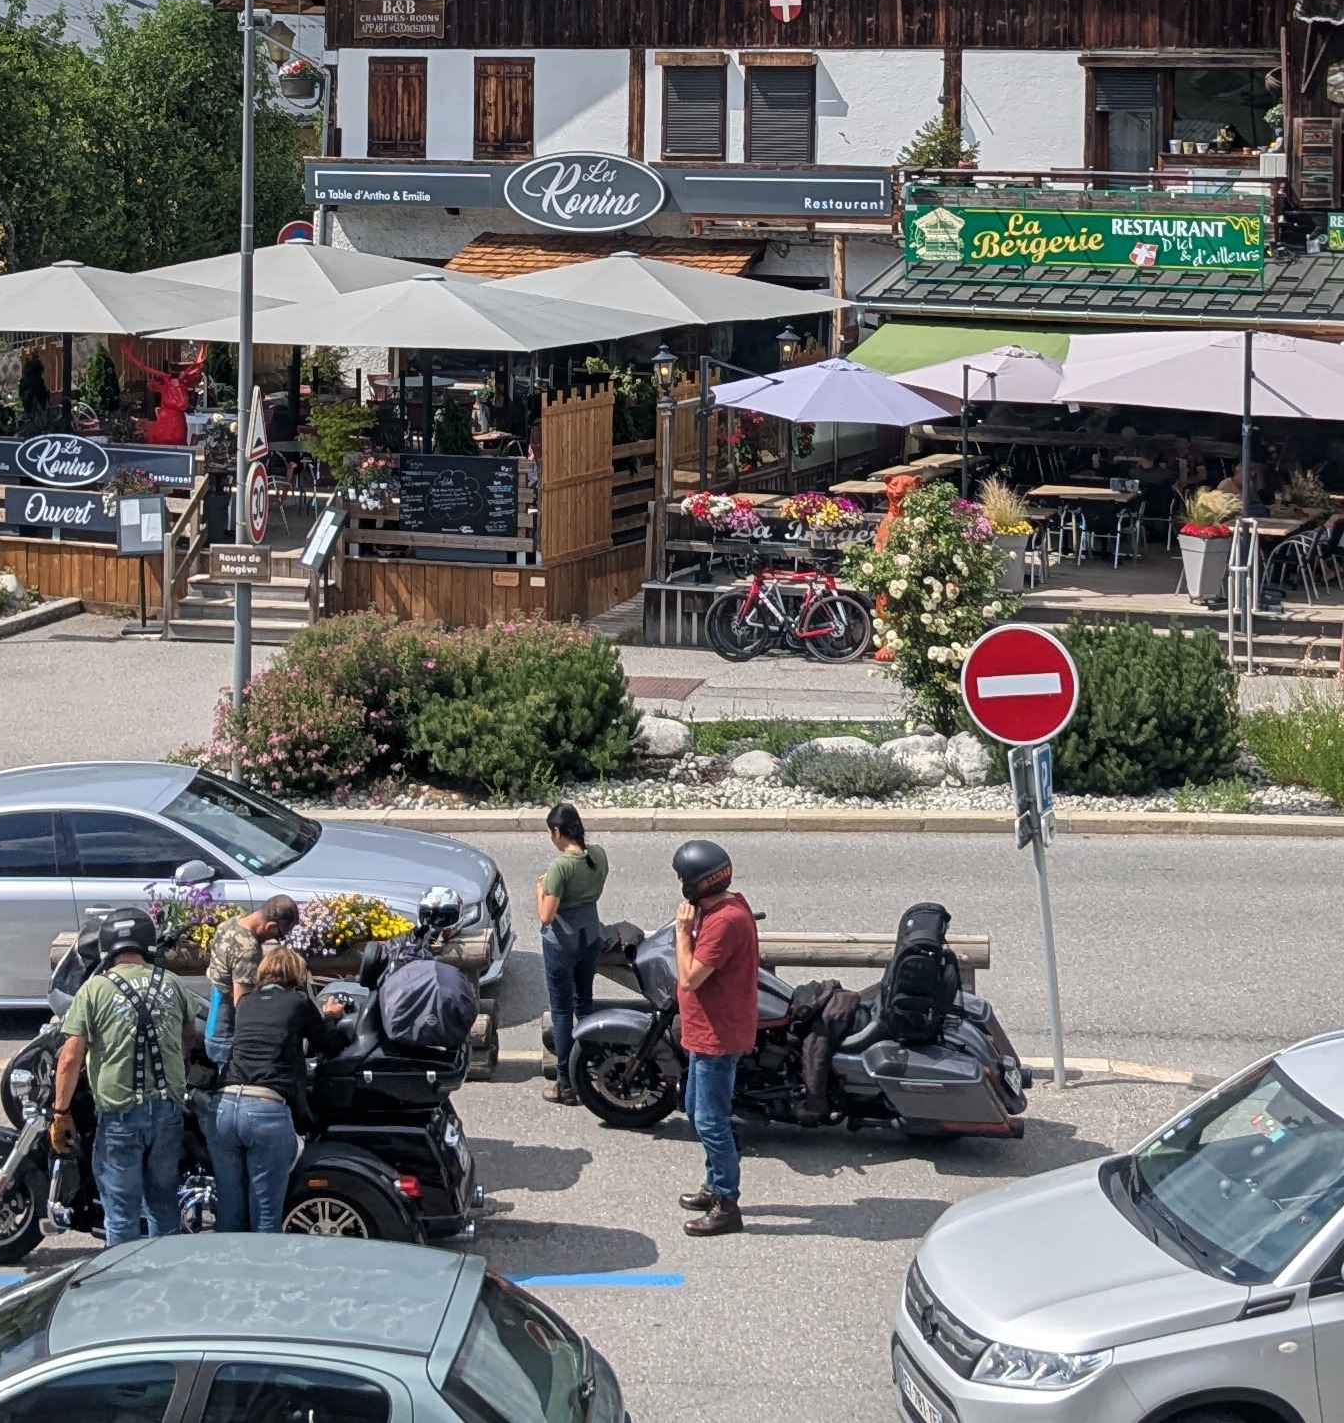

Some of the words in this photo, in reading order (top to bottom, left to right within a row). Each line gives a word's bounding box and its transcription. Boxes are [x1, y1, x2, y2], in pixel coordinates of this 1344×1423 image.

[382, 0, 416, 14] B&B
[582, 159, 617, 183] Les
[315, 189, 326, 199] La
[330, 189, 352, 200] Table
[355, 190, 390, 201] d'Antho
[393, 191, 400, 201] &
[403, 191, 430, 202] Emilie
[522, 161, 641, 220] Ronins
[804, 197, 885, 210] Restaurant
[1004, 214, 1043, 236] La
[1111, 218, 1226, 238] RESTAURANT
[971, 227, 1105, 264] Bergerie
[1180, 251, 1191, 262] &
[1192, 246, 1261, 266] d'ailleurs
[60, 439, 82, 455] Les
[25, 439, 95, 477] Ronins
[25, 492, 96, 525] Ouvert
[253, 485, 264, 521] 30
[219, 554, 246, 562] Route
[249, 554, 261, 562] de
